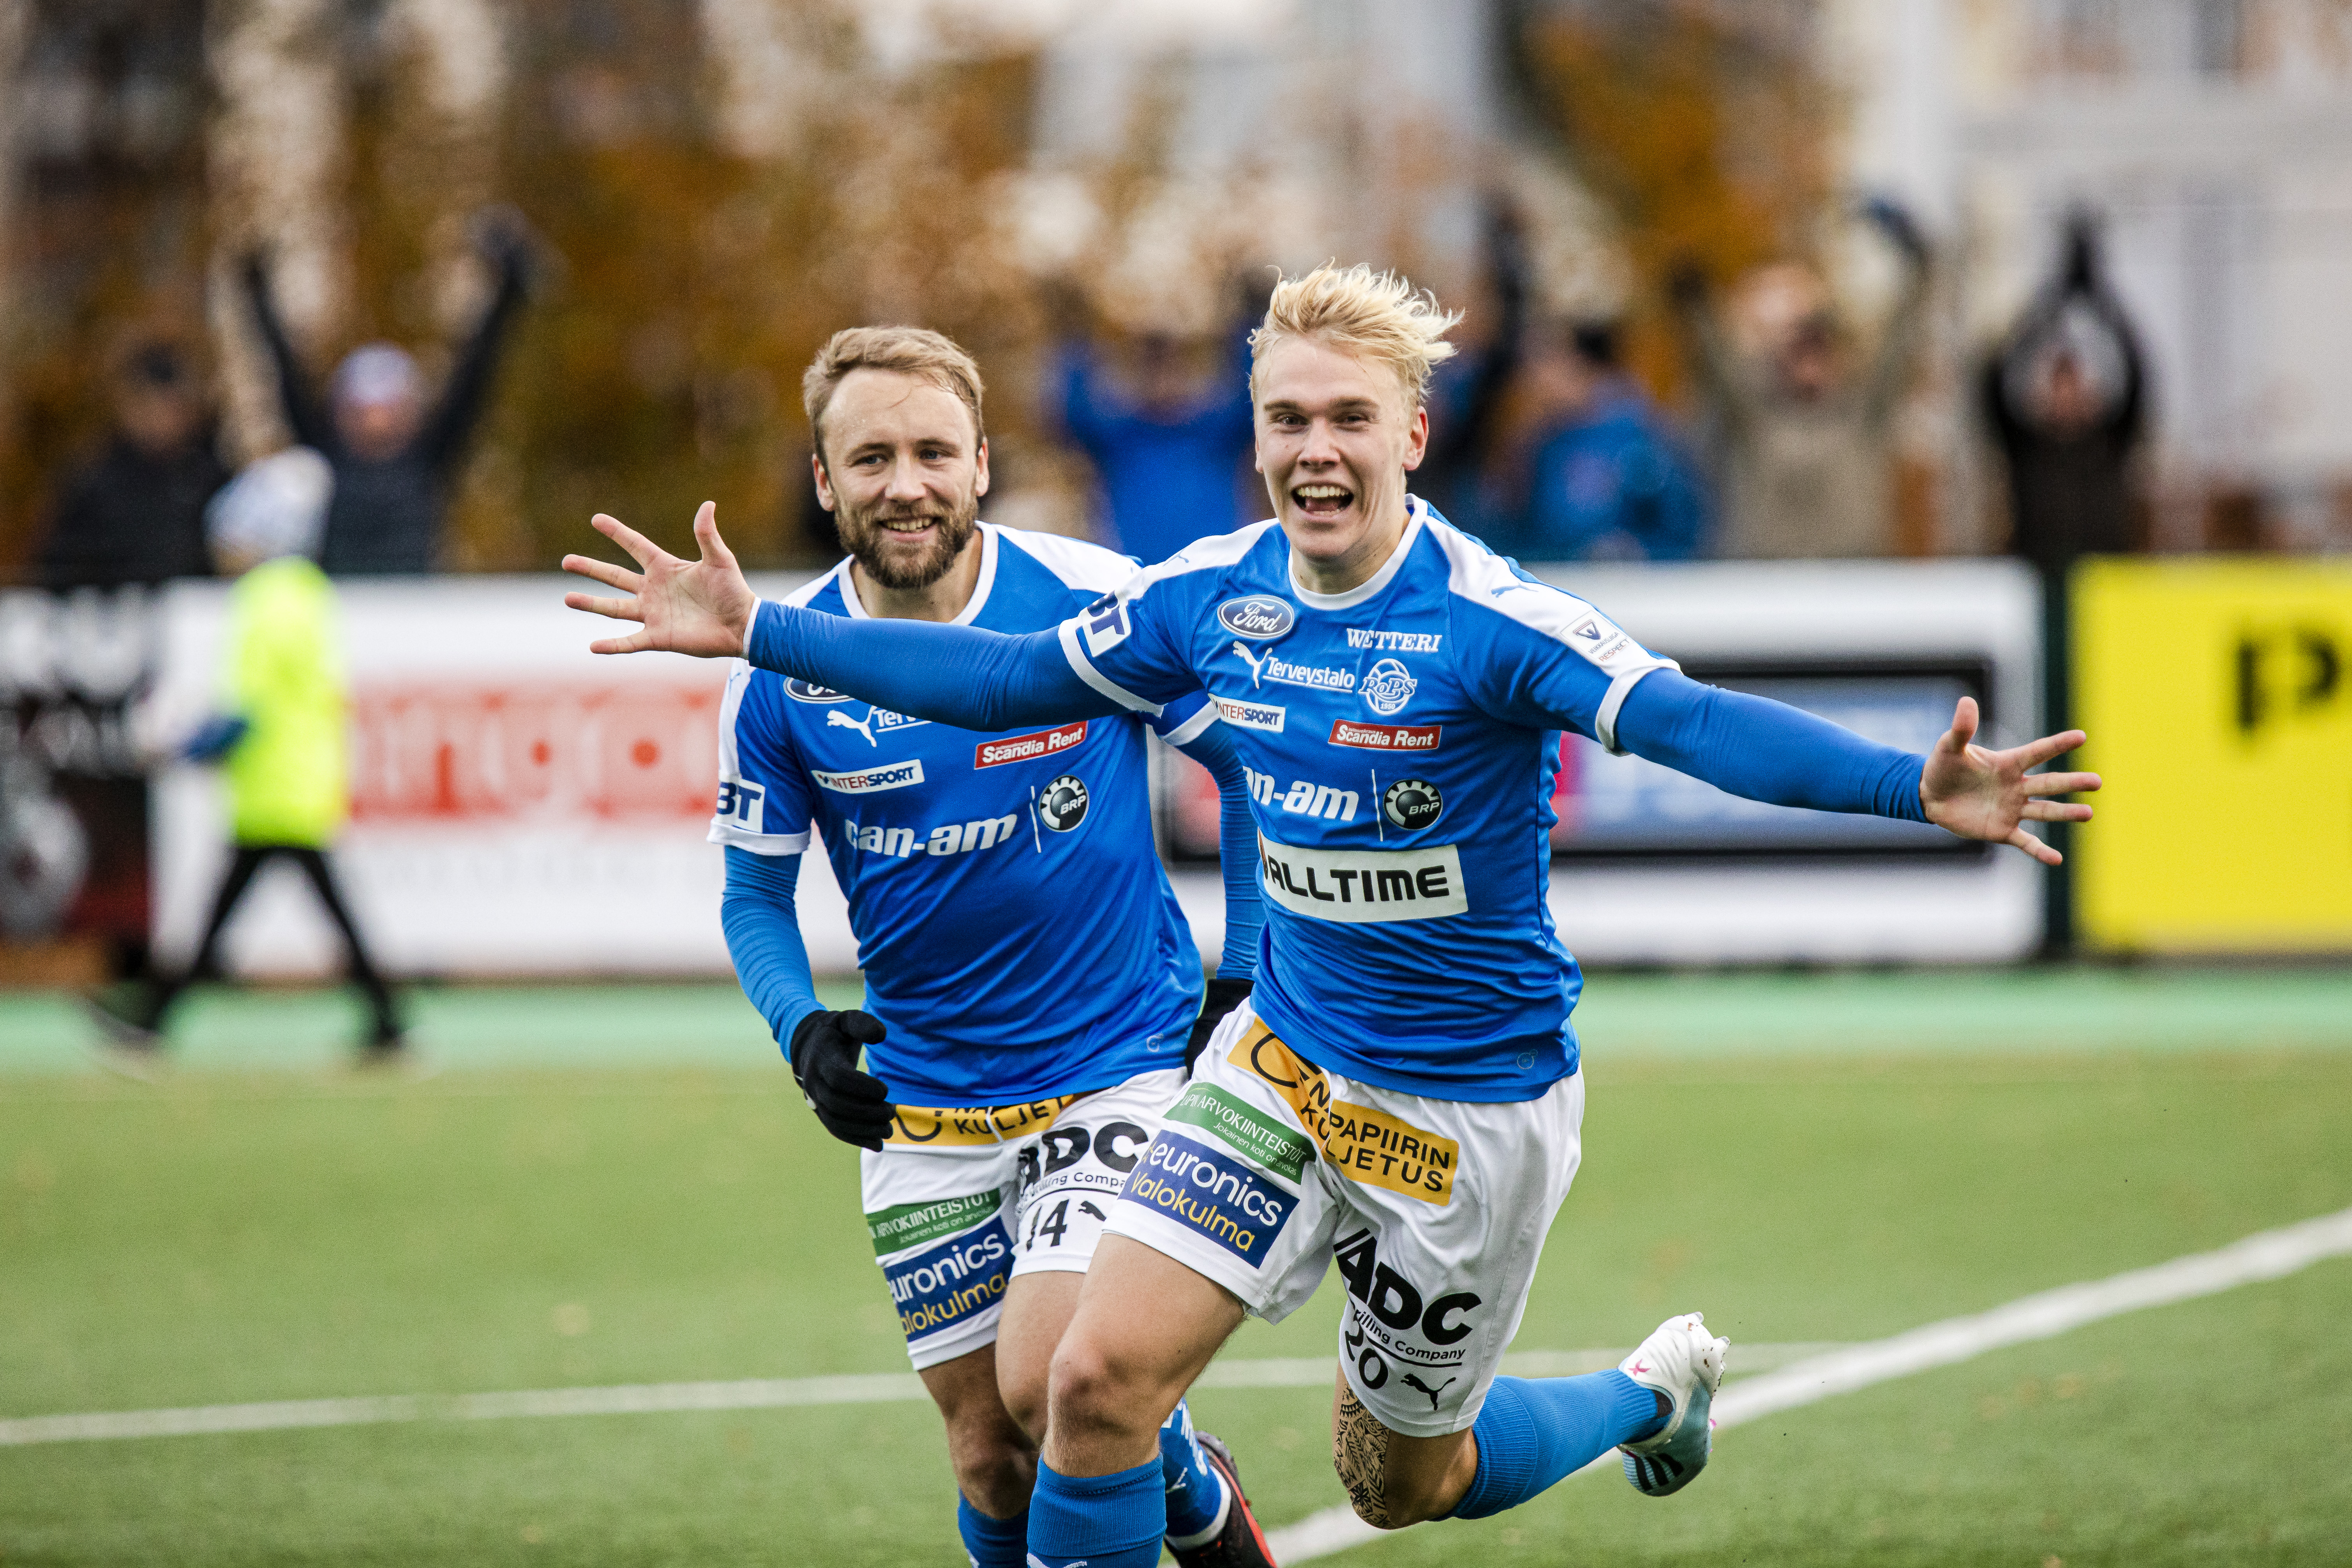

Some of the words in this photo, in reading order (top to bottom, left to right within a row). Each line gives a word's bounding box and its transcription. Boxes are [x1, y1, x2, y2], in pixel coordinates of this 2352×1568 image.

[1233, 602, 1283, 631] Ford
[1346, 628, 1442, 652] WETTERI
[1599, 638, 1629, 661] RESPECT
[1268, 656, 1355, 688] Terveystalo
[1358, 677, 1418, 700] RoPS
[983, 740, 1045, 763] Scandia
[1048, 727, 1083, 750] Rent
[1337, 724, 1390, 745] Scandia
[1394, 730, 1434, 746] Rent
[1060, 795, 1086, 815] BRP
[1409, 802, 1440, 815] BRP
[845, 814, 1018, 858] can-am
[1267, 854, 1450, 903] ALLTIME
[1196, 1095, 1306, 1163] ARVOKIINTEISTÖT
[1213, 1122, 1249, 1148] Jokainen
[1250, 1143, 1267, 1157] koti
[1266, 1154, 1278, 1165] on
[1276, 1159, 1297, 1176] arvokas
[1150, 1143, 1283, 1226] euronics
[1130, 1171, 1256, 1252] Valokulma
[1333, 1227, 1482, 1346] ADC
[1353, 1309, 1391, 1344] rilling
[1395, 1340, 1466, 1362] Company
